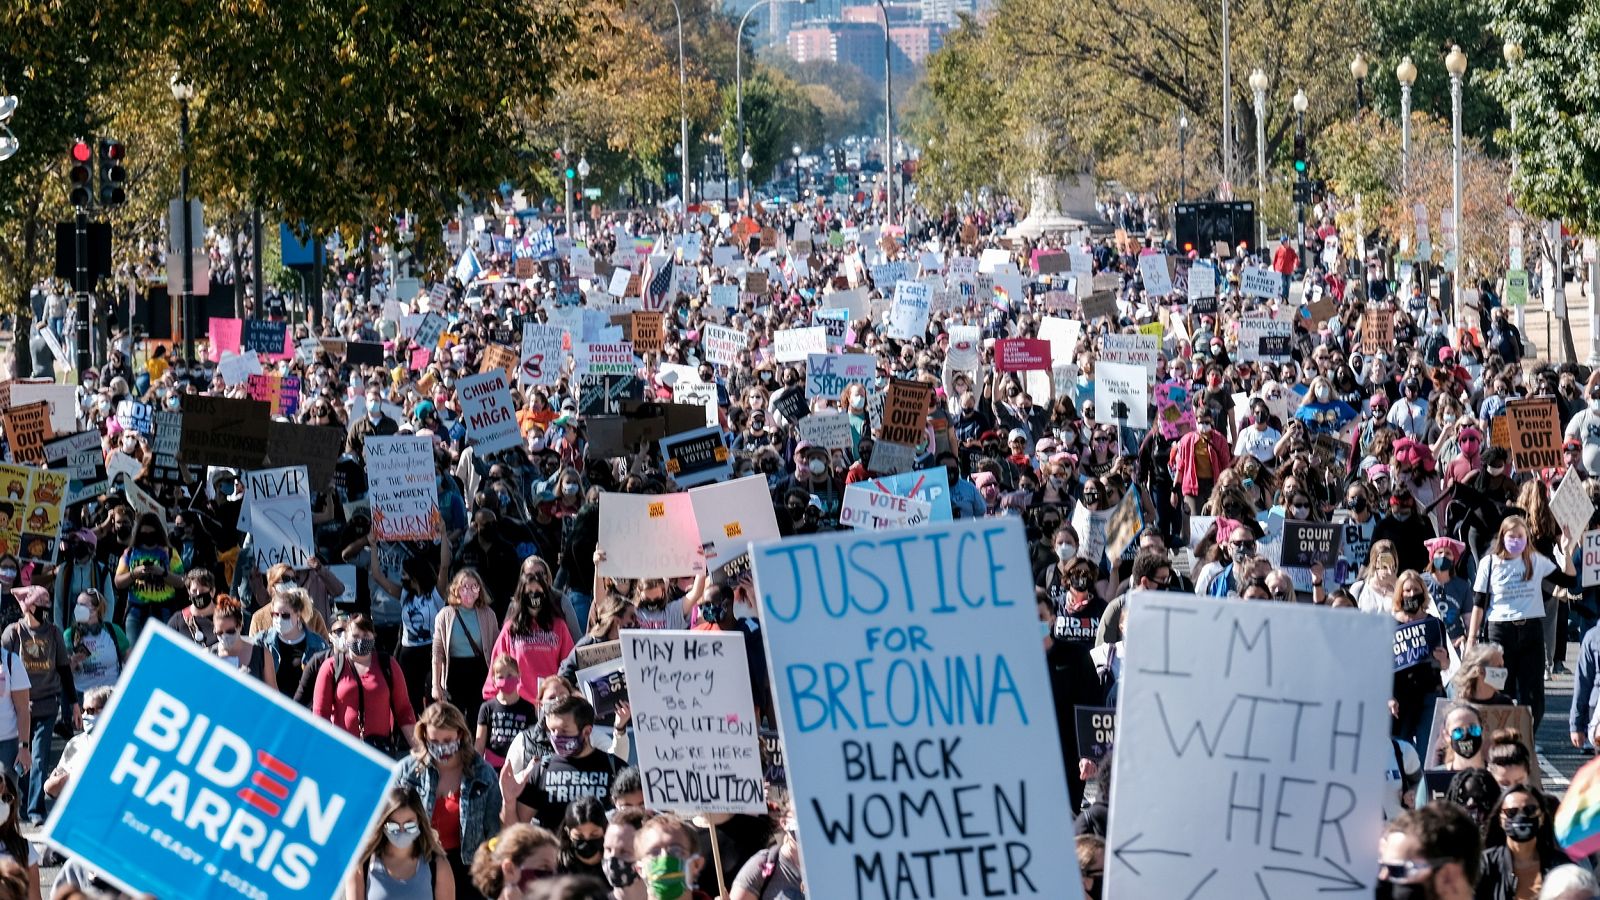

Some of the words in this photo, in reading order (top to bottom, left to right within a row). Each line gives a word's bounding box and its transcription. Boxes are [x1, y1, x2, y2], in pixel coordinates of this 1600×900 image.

[816, 318, 846, 327] VOTE
[637, 329, 658, 339] OUT
[708, 327, 726, 339] KEEP
[1367, 331, 1387, 340] OUT
[588, 343, 633, 353] EQUALITY
[634, 339, 662, 351] NOW!
[588, 354, 632, 363] JUSTICE
[588, 363, 633, 373] EMPATHY
[809, 356, 838, 377] WE
[463, 377, 505, 400] CHINGA
[580, 374, 604, 386] VOTE
[892, 386, 927, 401] Trump/
[117, 400, 153, 422] NO!
[892, 398, 923, 410] Pence
[1511, 406, 1553, 420] Trump/
[9, 407, 45, 423] Trump/
[470, 406, 511, 431] MAGA
[891, 409, 920, 425] OUT
[1516, 418, 1553, 431] Pence
[12, 420, 45, 433] Pence
[881, 426, 922, 444] NOW!
[16, 429, 45, 448] OUT
[674, 438, 716, 457] FEMINIST
[1520, 431, 1553, 449] OUT
[366, 443, 386, 457] WE
[388, 441, 409, 455] ARE
[411, 440, 429, 452] THE
[684, 451, 712, 464] VOTER
[1516, 449, 1563, 469] NOW!
[252, 469, 306, 500] NEVER
[392, 487, 432, 499] WEREN'T
[379, 502, 405, 514] ABLE
[414, 501, 428, 511] TO
[869, 492, 907, 513] VOTE
[841, 507, 870, 525] OUT
[1297, 527, 1334, 541] COUNT
[1300, 540, 1315, 552] ON
[1319, 540, 1331, 552] US
[256, 544, 311, 568] AGAIN
[765, 527, 1015, 624] JUSTICE
[1056, 616, 1099, 629] BIDEN
[865, 625, 934, 653] FOR
[1395, 623, 1427, 642] OUNT
[632, 638, 674, 662] MAY
[683, 640, 724, 660] HER
[1138, 605, 1273, 687] I'M
[1393, 642, 1408, 655] ON
[1411, 635, 1427, 649] US
[608, 673, 622, 693] US
[640, 666, 715, 695] Memory
[690, 697, 703, 709] A
[785, 653, 1029, 734] BREONNA
[636, 712, 754, 740] REVOLUTION
[1092, 713, 1118, 730] COU
[1154, 691, 1366, 775] WITH
[654, 744, 704, 763] WE'RE
[710, 745, 752, 762] HERE
[841, 736, 963, 782] BLACK
[133, 687, 347, 847] BIDEN
[545, 770, 609, 787] IMPEACH
[645, 767, 764, 804] REVOLUTION
[545, 783, 608, 803] TRUMP
[109, 741, 319, 891] HARRIS
[811, 780, 1028, 846] WOMEN
[1225, 770, 1358, 865] HER
[150, 827, 204, 867] READY
[853, 841, 1039, 900] MATTER
